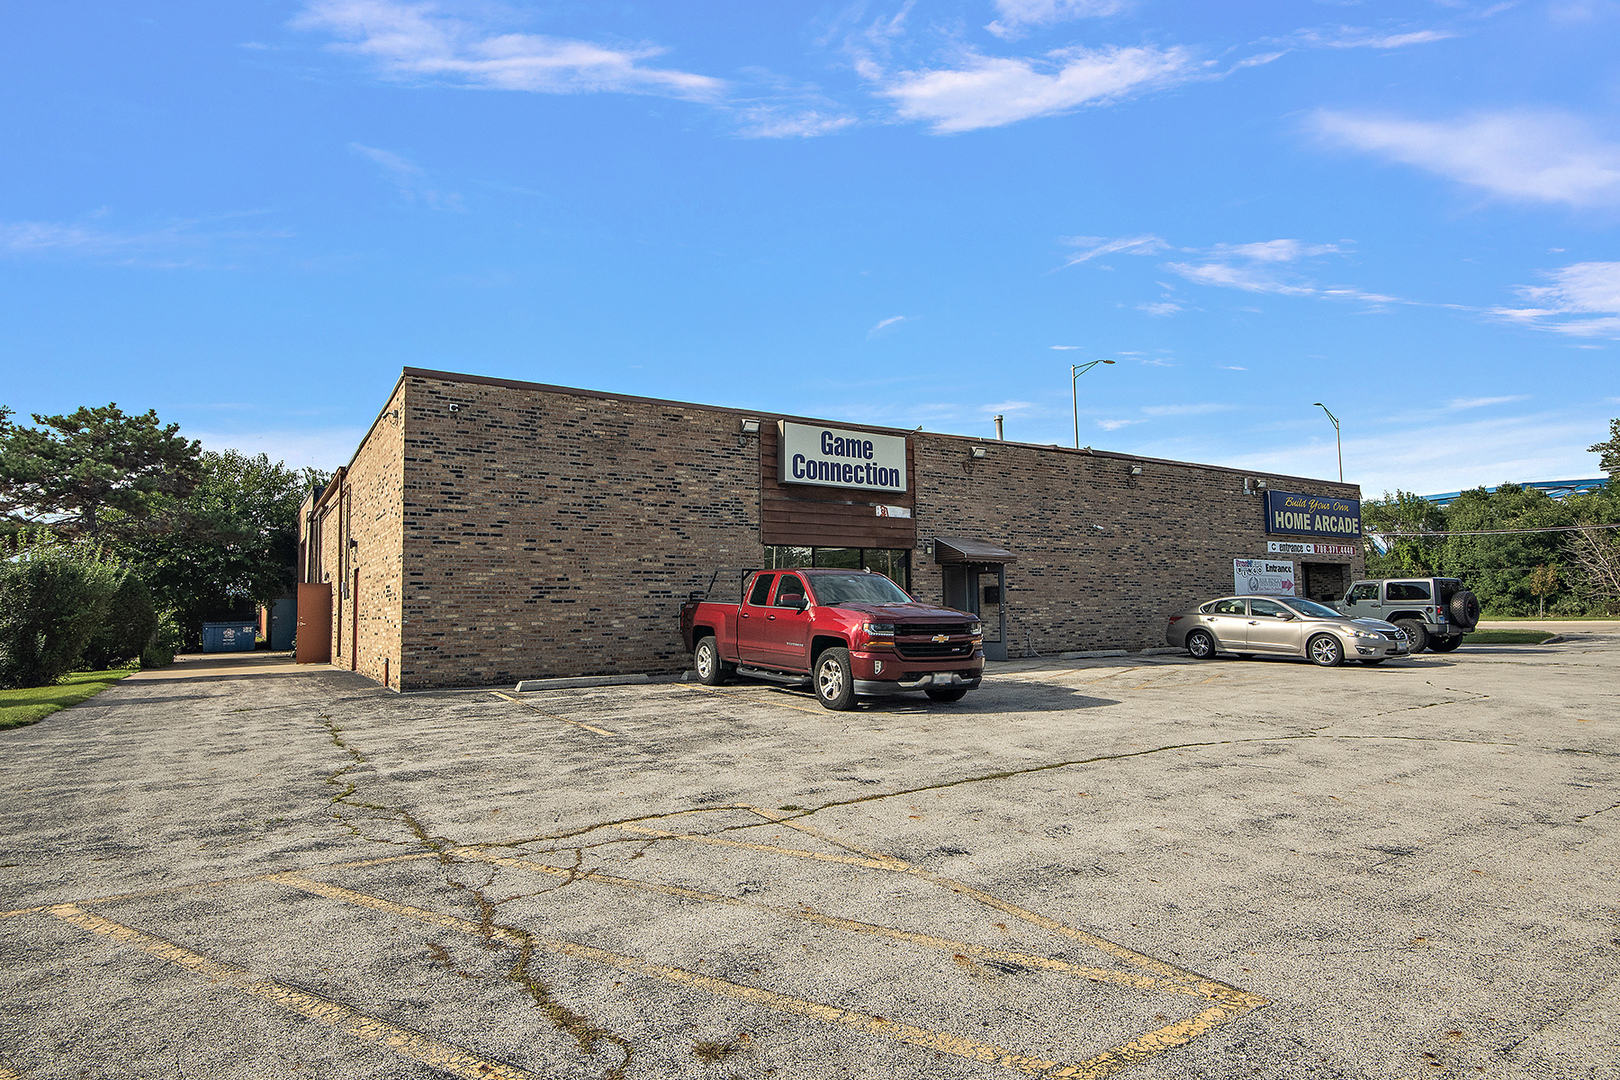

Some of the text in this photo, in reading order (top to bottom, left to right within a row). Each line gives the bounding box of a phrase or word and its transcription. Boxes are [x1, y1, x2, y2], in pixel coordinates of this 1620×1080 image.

[821, 430, 873, 459] Game
[792, 453, 900, 487] Connection
[1285, 497, 1349, 513] Build Your Own
[1275, 511, 1359, 534] HOME ARCADE
[1279, 543, 1303, 552] entrance
[1265, 563, 1292, 573] Entrance
